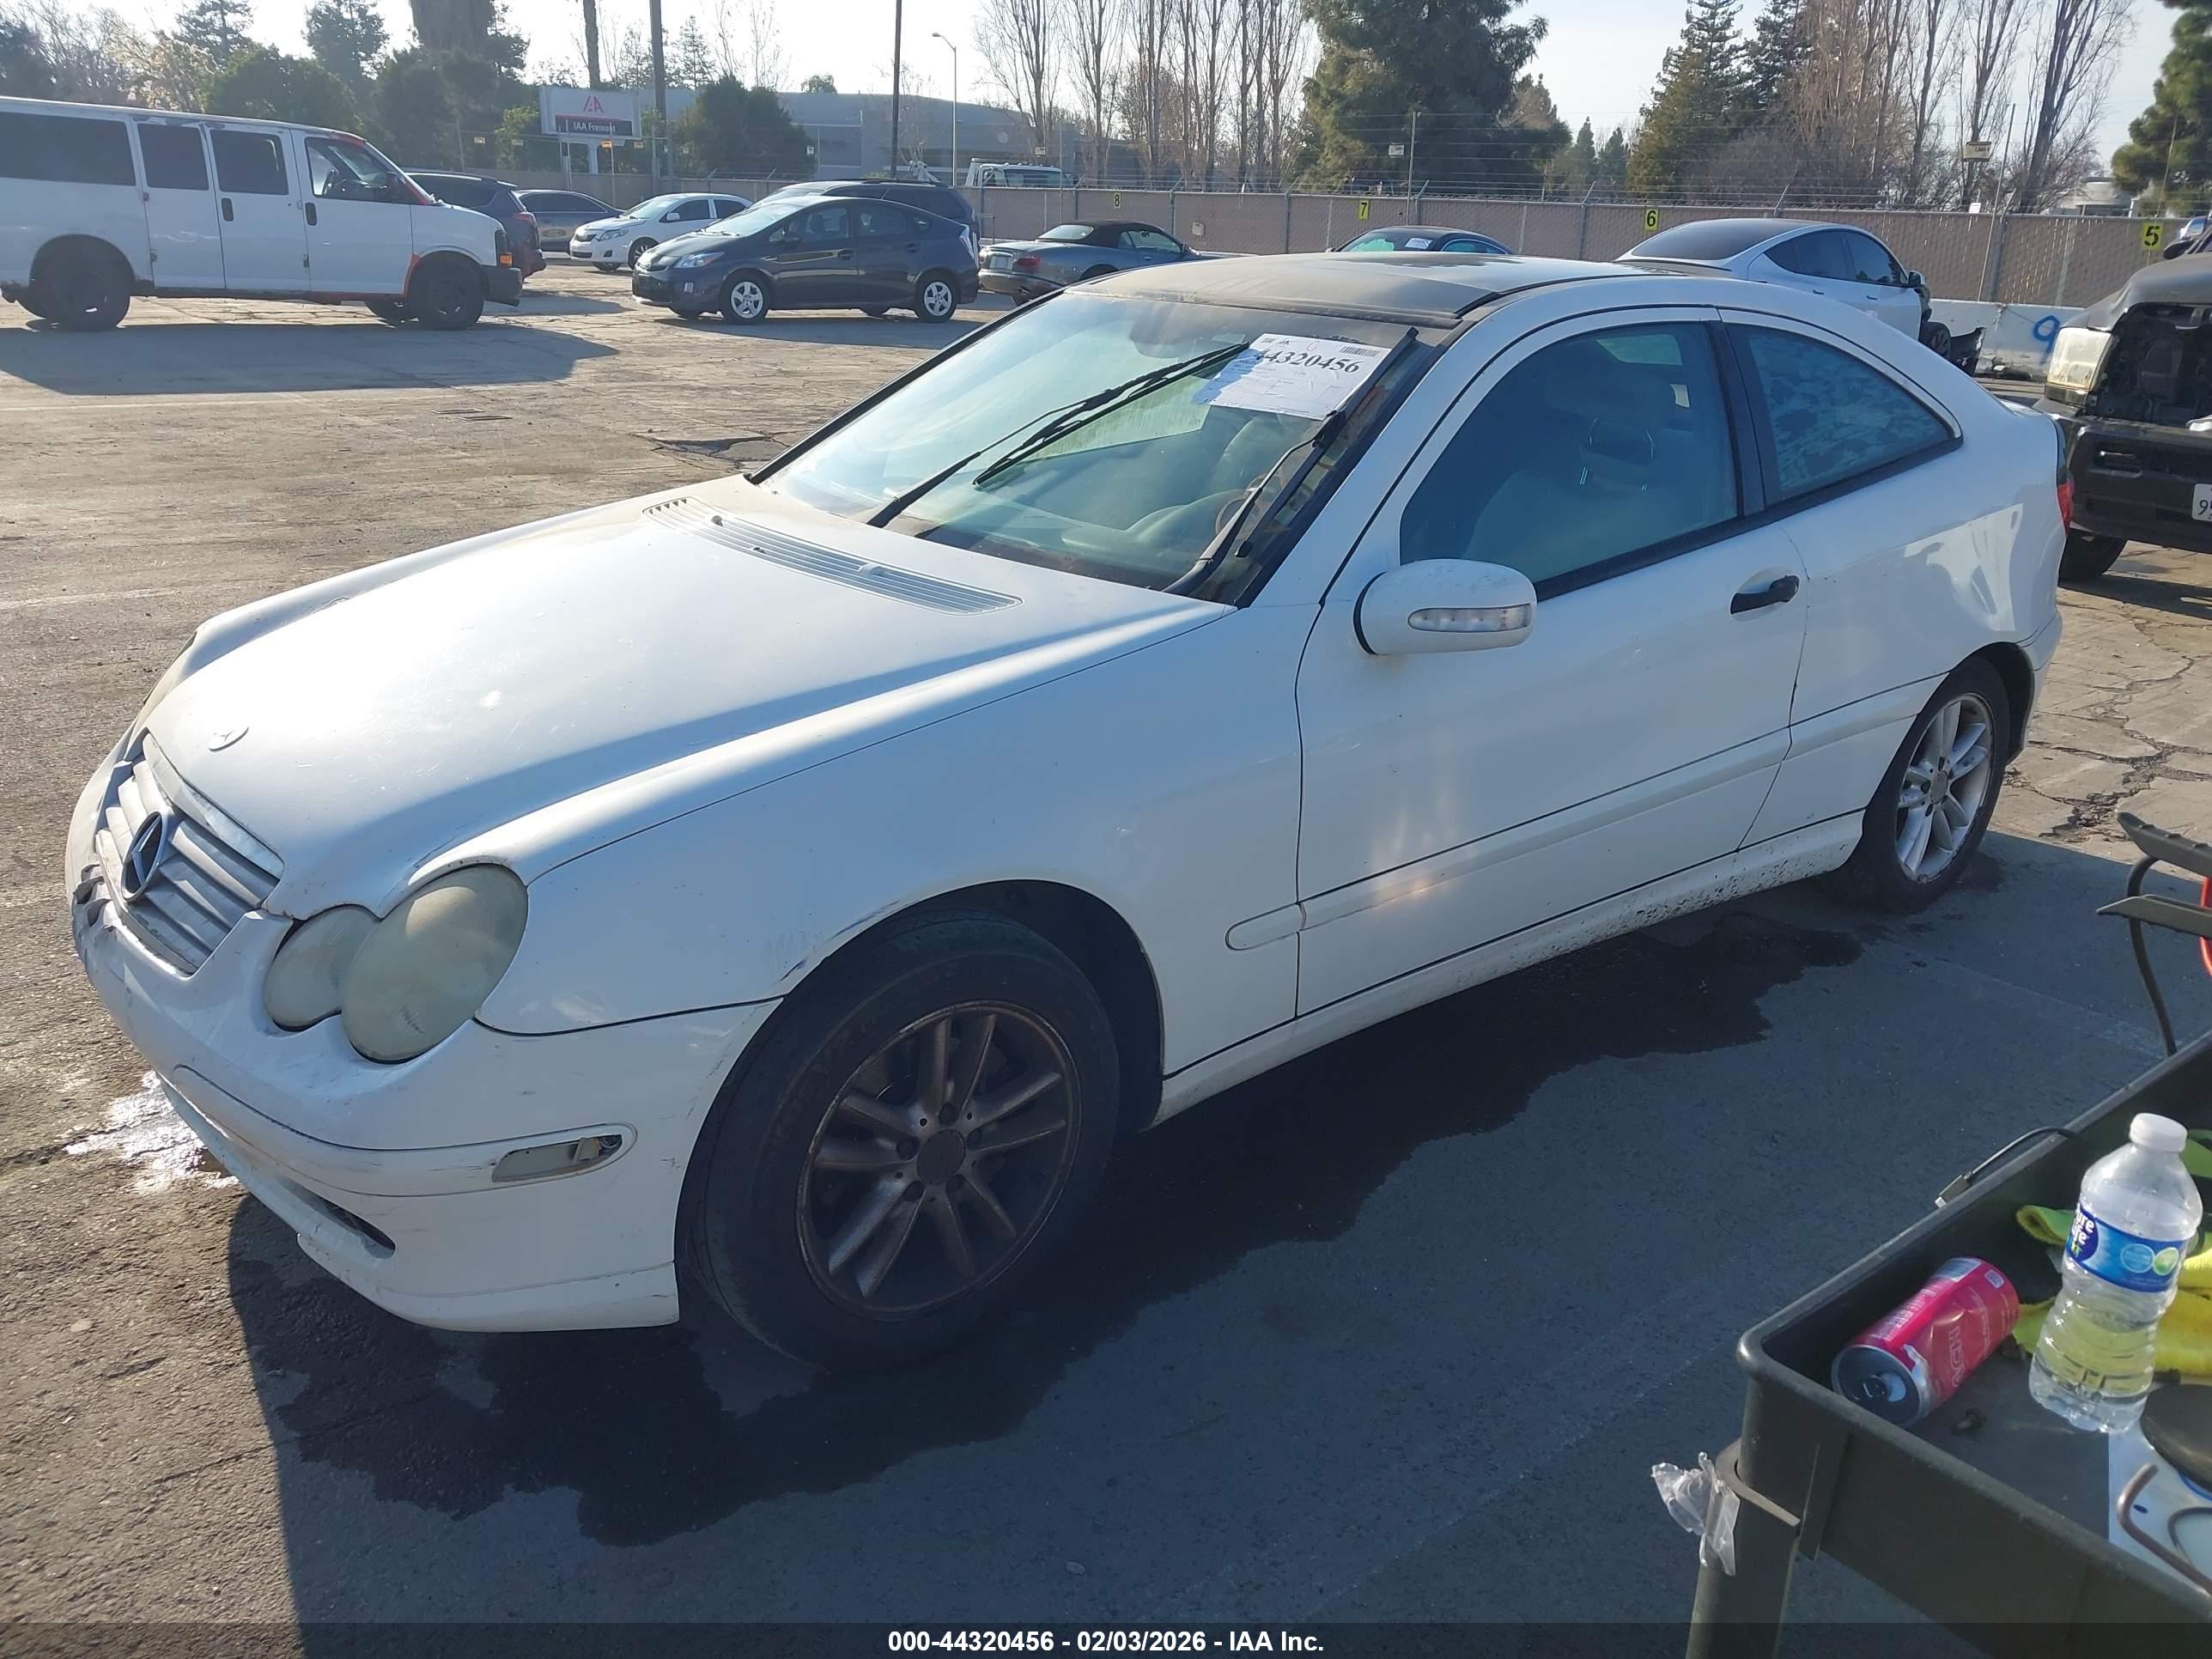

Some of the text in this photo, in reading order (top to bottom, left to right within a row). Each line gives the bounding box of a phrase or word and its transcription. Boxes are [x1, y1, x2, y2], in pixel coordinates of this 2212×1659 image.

[574, 122, 586, 131] IAA
[1115, 194, 1120, 207] 8
[1361, 203, 1367, 216] 7
[1647, 210, 1656, 227] 6
[2144, 226, 2160, 246] 5
[2033, 315, 2060, 365] 9
